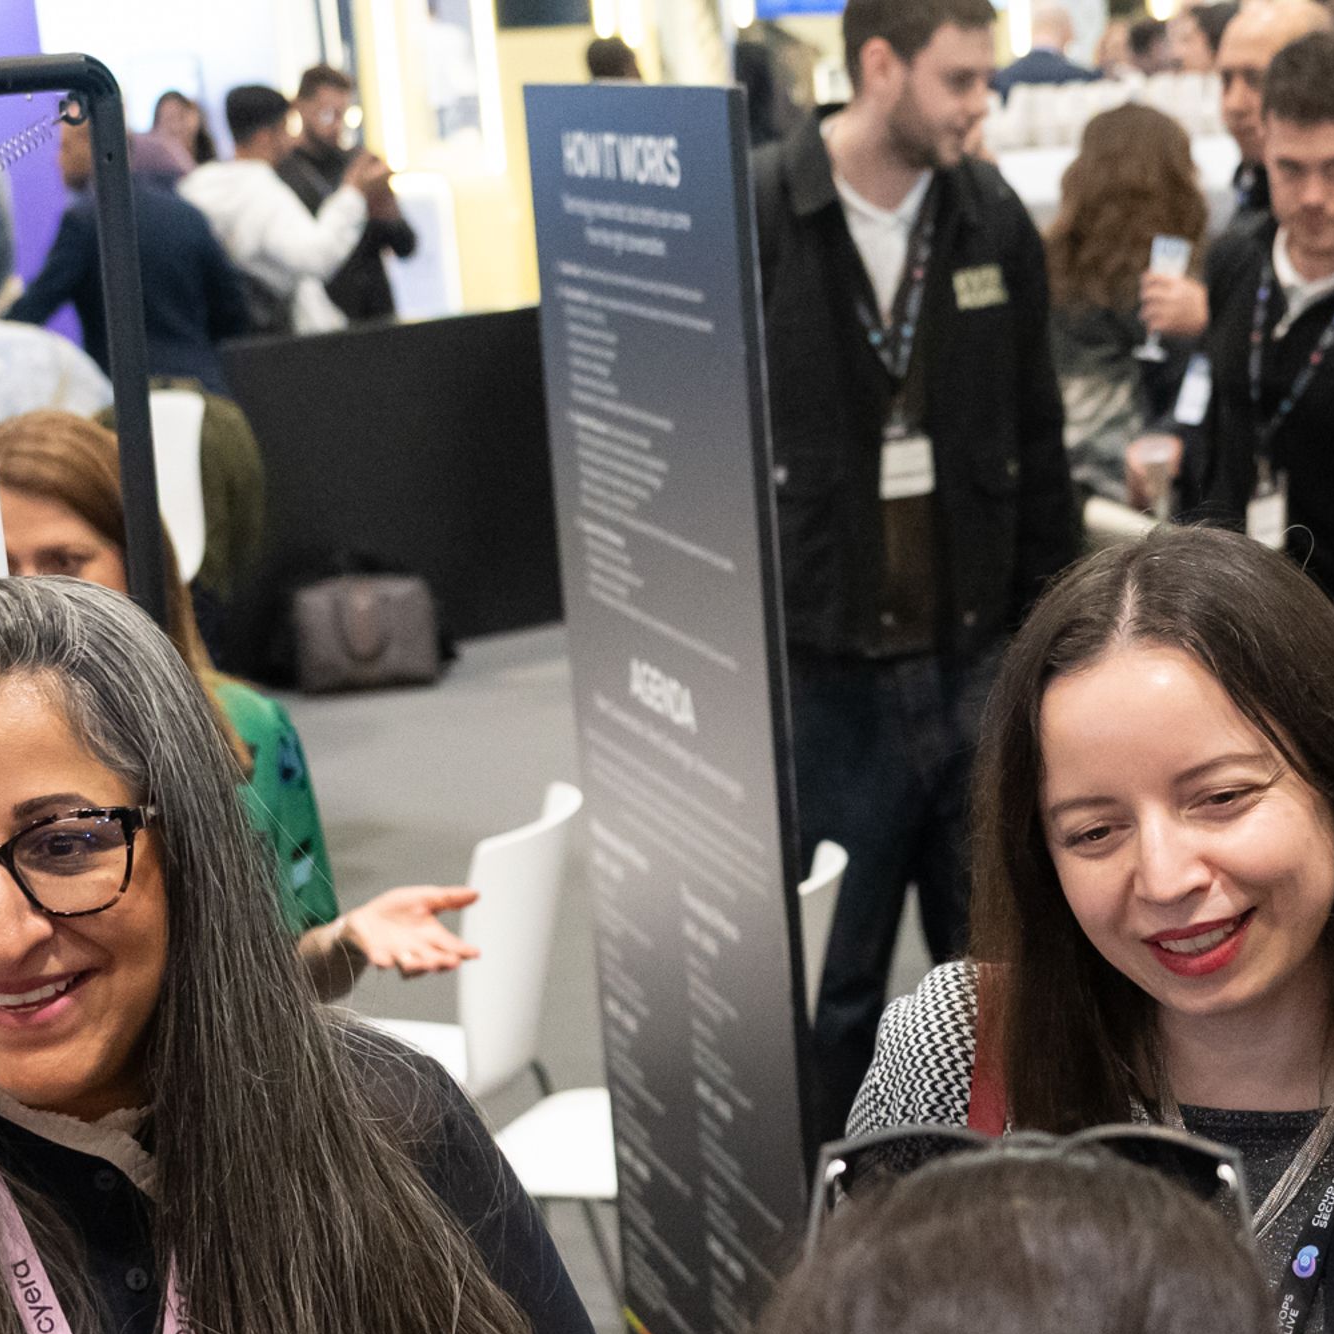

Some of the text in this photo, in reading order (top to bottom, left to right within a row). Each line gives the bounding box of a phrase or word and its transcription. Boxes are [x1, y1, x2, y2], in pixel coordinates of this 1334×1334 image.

[616, 134, 681, 188] WORKS
[629, 658, 698, 735] AGENDA
[1312, 1185, 1334, 1228] CLOUD
[11, 1259, 56, 1334] cyera
